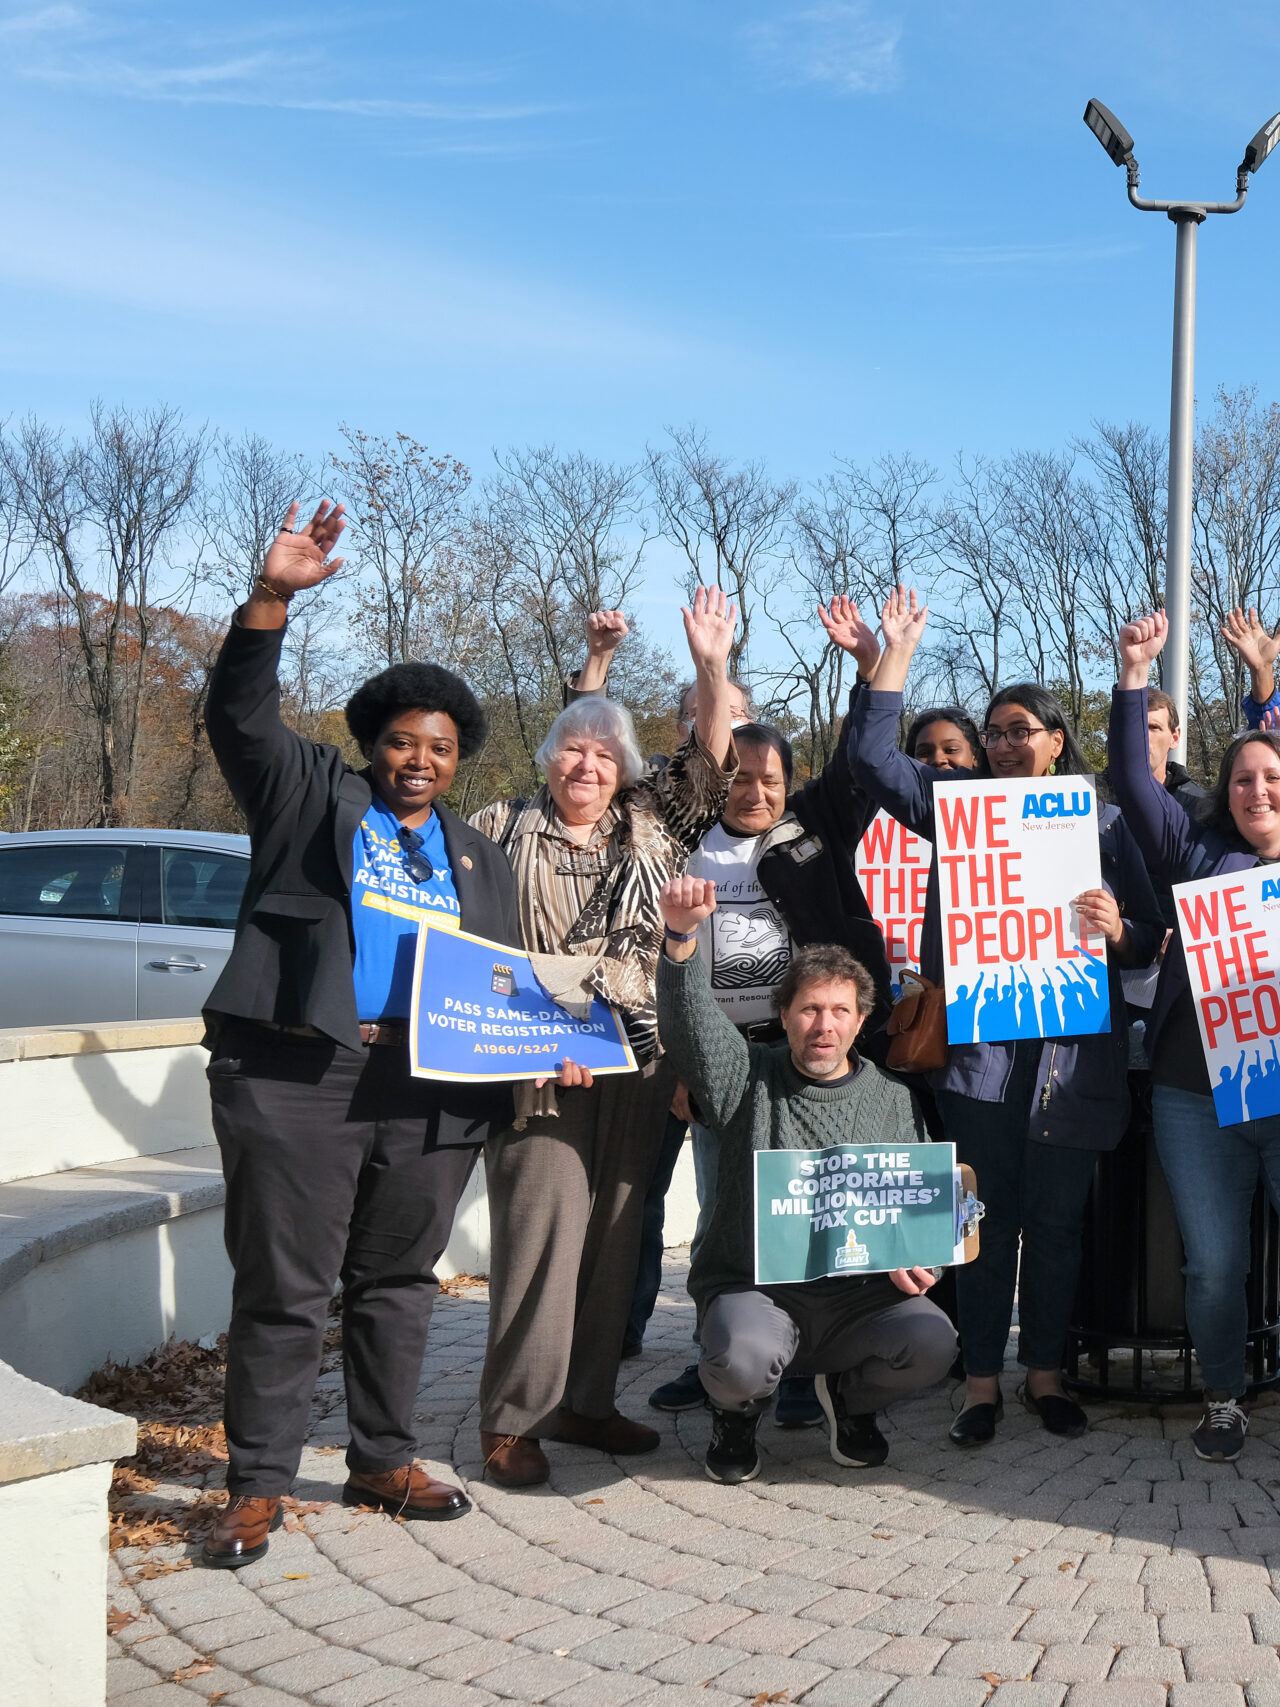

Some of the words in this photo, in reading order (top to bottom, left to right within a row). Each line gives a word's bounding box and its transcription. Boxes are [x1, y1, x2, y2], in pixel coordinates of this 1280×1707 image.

[1021, 791, 1091, 819] ACLU
[938, 795, 1009, 850] WE
[1022, 821, 1043, 832] New
[1045, 820, 1076, 831] Jersey
[862, 818, 920, 864] WE
[354, 868, 461, 912] REGISTRATI
[732, 881, 745, 898] of
[859, 868, 930, 914] THE
[940, 852, 1024, 908] THE
[1178, 885, 1252, 941] WE
[947, 907, 1104, 966] PEOPLE
[1186, 930, 1276, 993] THE
[444, 997, 482, 1017] PASS
[739, 994, 774, 1002] Resour
[427, 1011, 477, 1034] VOTER
[481, 1023, 606, 1037] REGISTRATION
[473, 1043, 559, 1055] A1966/S247
[799, 1153, 858, 1176] STOP
[862, 1152, 911, 1170] THE
[788, 1170, 924, 1196] CORPORATE
[771, 1187, 941, 1216] MILLIONAIRES'
[809, 1208, 848, 1233] TAX
[853, 1207, 903, 1226] CUT
